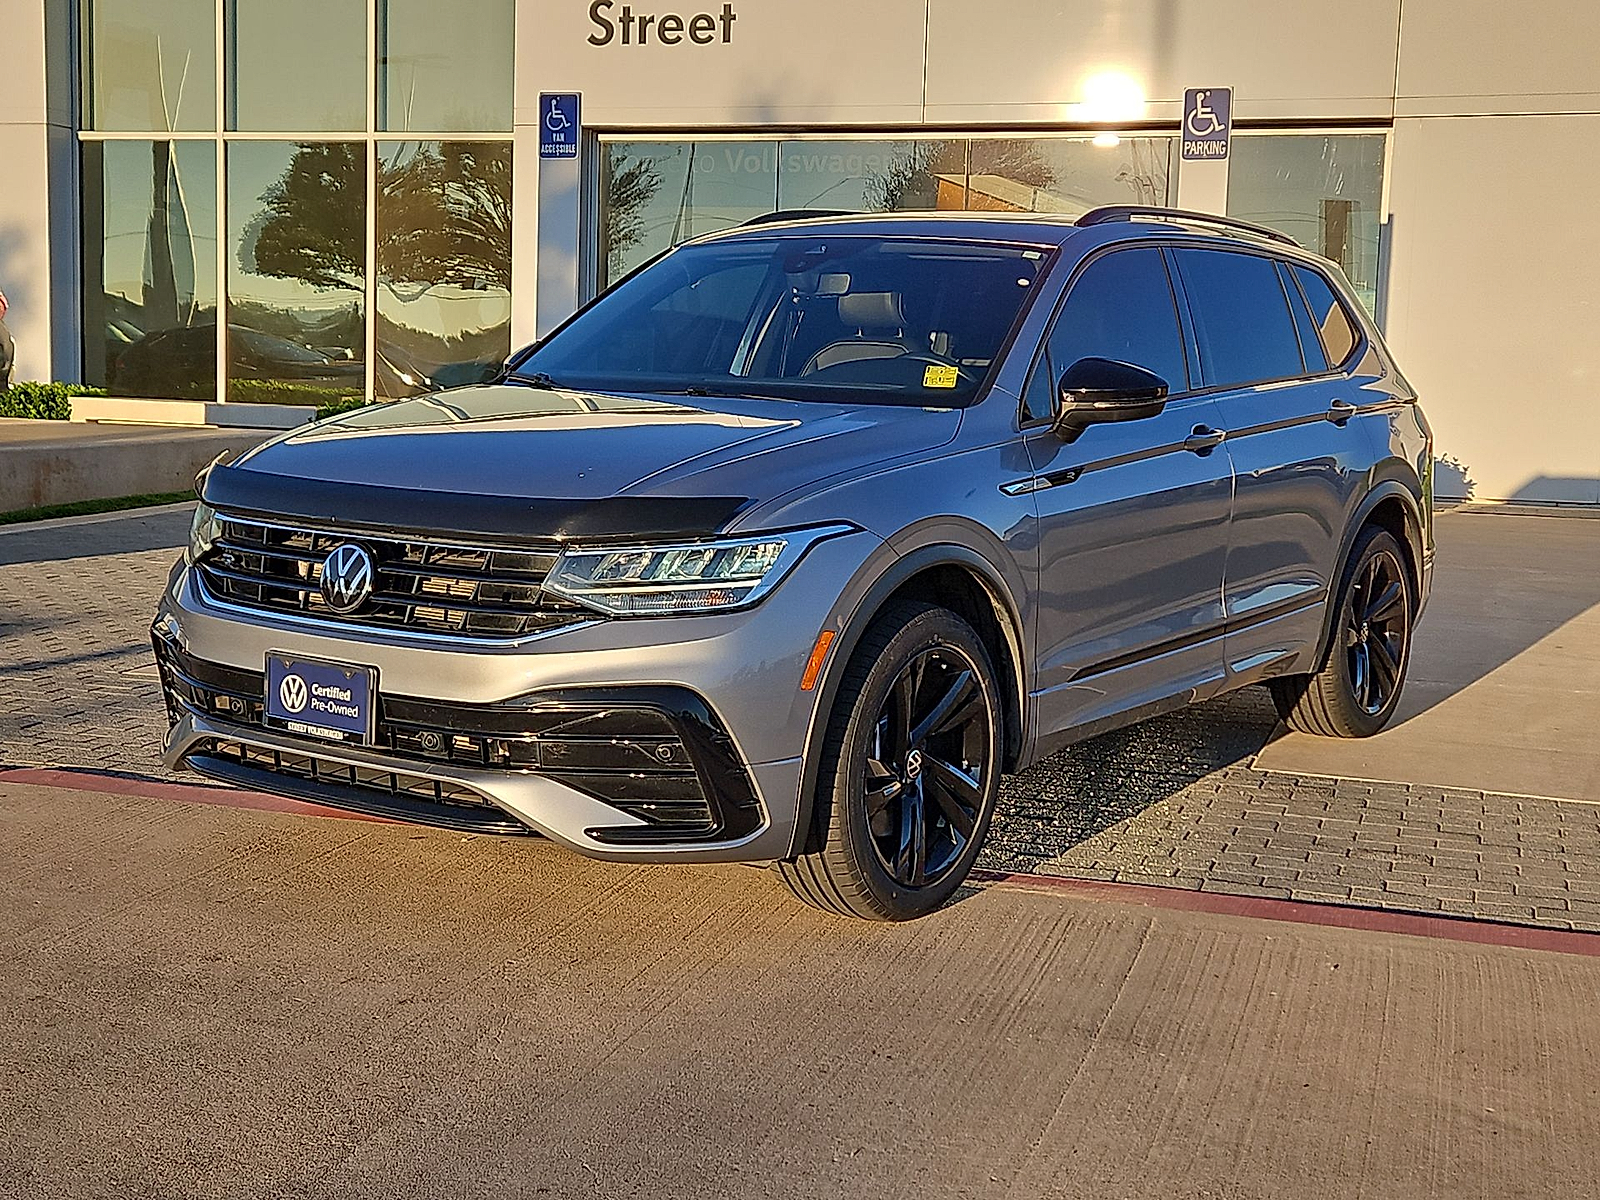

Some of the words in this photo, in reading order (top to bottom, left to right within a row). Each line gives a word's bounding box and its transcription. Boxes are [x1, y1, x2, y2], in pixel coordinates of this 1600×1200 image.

[587, 0, 736, 46] Street
[541, 143, 576, 153] ACCESSIBLE
[1184, 140, 1227, 156] PARKING
[311, 683, 351, 702] Certified
[311, 697, 359, 718] Pre-Owned
